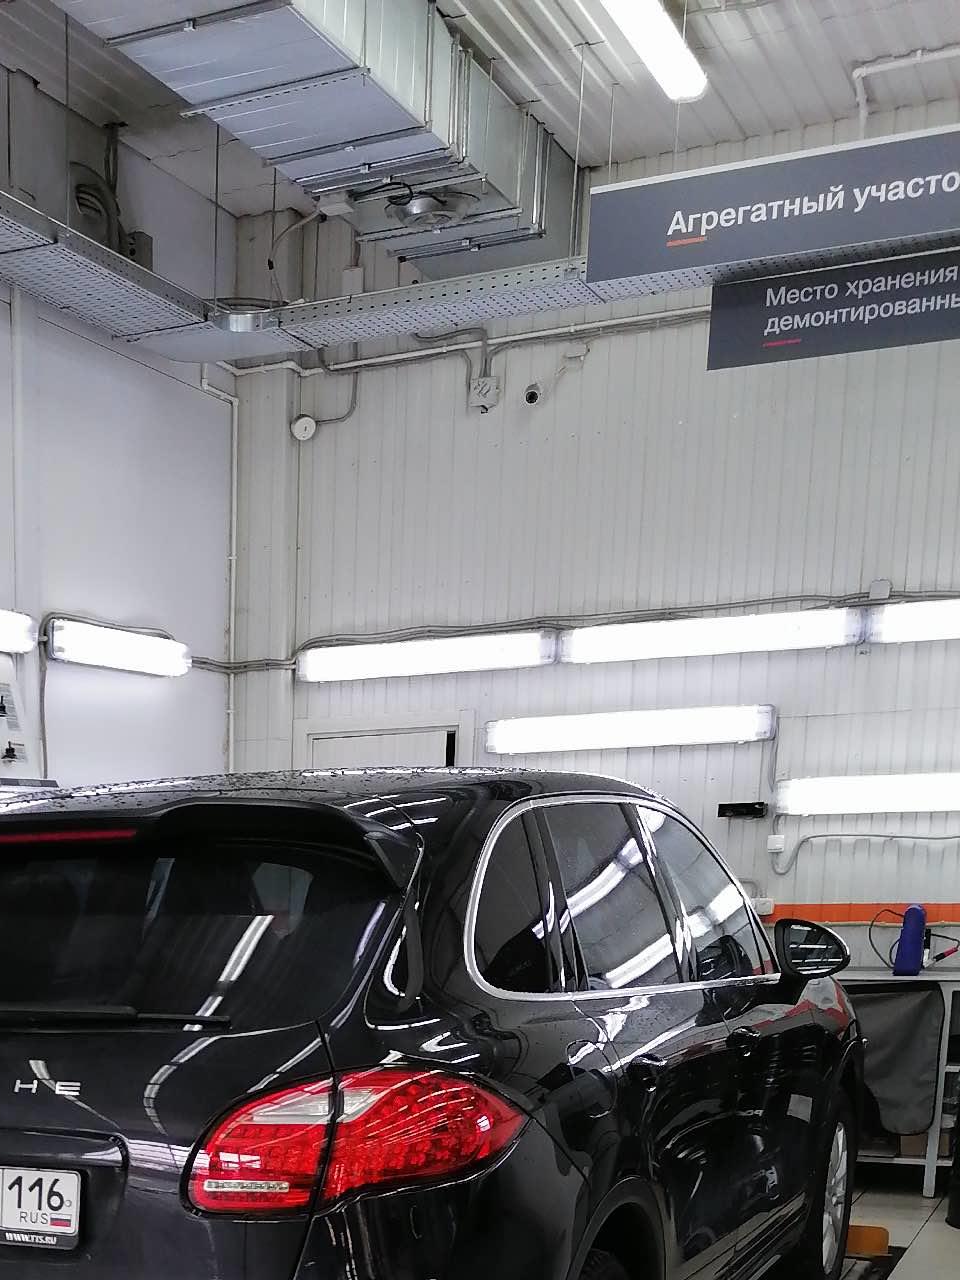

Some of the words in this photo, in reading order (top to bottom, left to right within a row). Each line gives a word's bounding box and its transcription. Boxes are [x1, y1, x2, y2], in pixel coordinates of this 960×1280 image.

[666, 185, 844, 236] Агрегатный
[852, 170, 960, 213] участо
[765, 282, 839, 307] Место
[845, 265, 959, 298] хранения
[7, 1176, 64, 1211] 116
[19, 1211, 48, 1225] RUS
